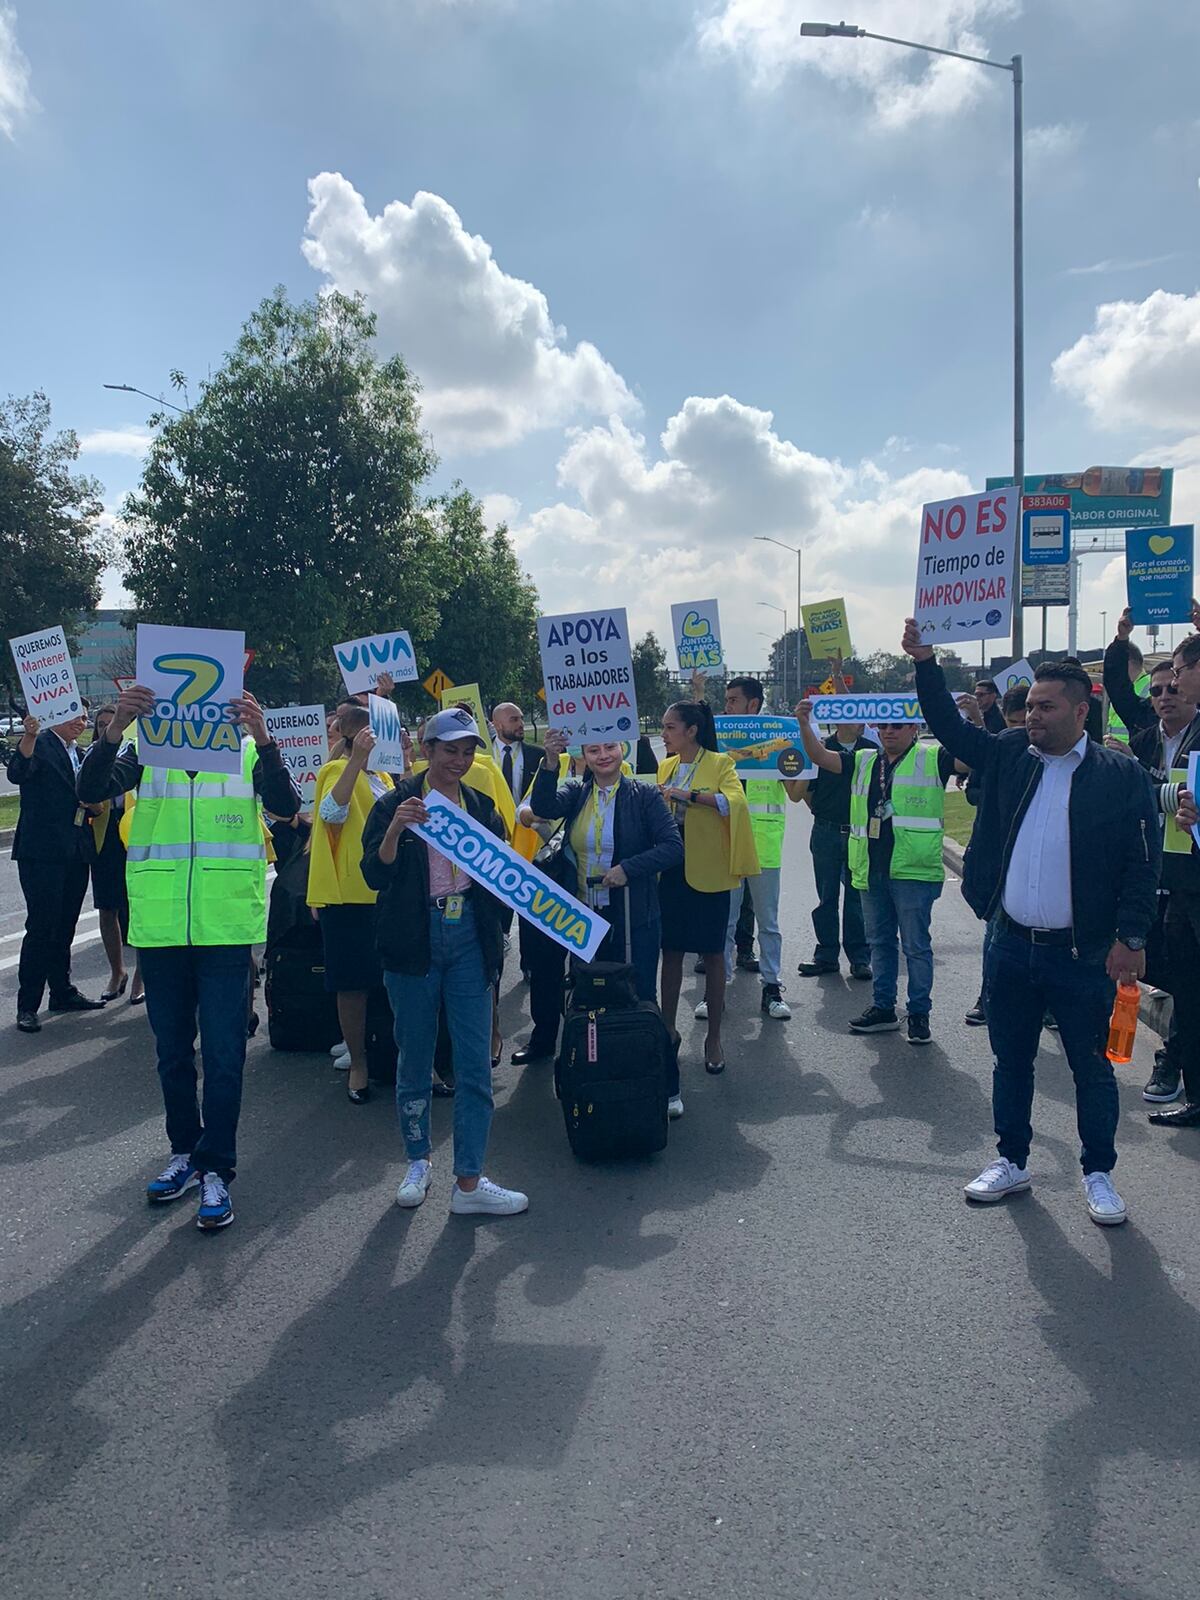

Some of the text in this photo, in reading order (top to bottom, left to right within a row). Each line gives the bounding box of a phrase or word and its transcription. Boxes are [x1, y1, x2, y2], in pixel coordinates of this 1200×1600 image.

[924, 496, 1007, 544] NO ES
[1070, 508, 1160, 521] SABOR ORIGINAL
[923, 545, 1005, 575] Tiempo de
[918, 576, 1006, 609] IMPROVISAR
[1147, 607, 1169, 615] VIVA
[547, 616, 621, 648] APOYA
[15, 634, 62, 658] ¡QUEREMOS
[338, 637, 412, 673] VIVA
[565, 648, 608, 667] a los
[21, 652, 66, 674] Mantener
[29, 669, 69, 689] Viva a
[547, 667, 630, 691] TRABAJADORES
[31, 682, 73, 704] VIVA!
[552, 692, 631, 716] de VIVA
[141, 718, 241, 751] VIVA
[716, 730, 801, 740] marillo que nunca!
[723, 720, 760, 729] corazón
[762, 720, 783, 729] más
[275, 735, 323, 749] antener
[312, 754, 322, 767] a
[423, 810, 588, 946] #SOMOSVIVA
